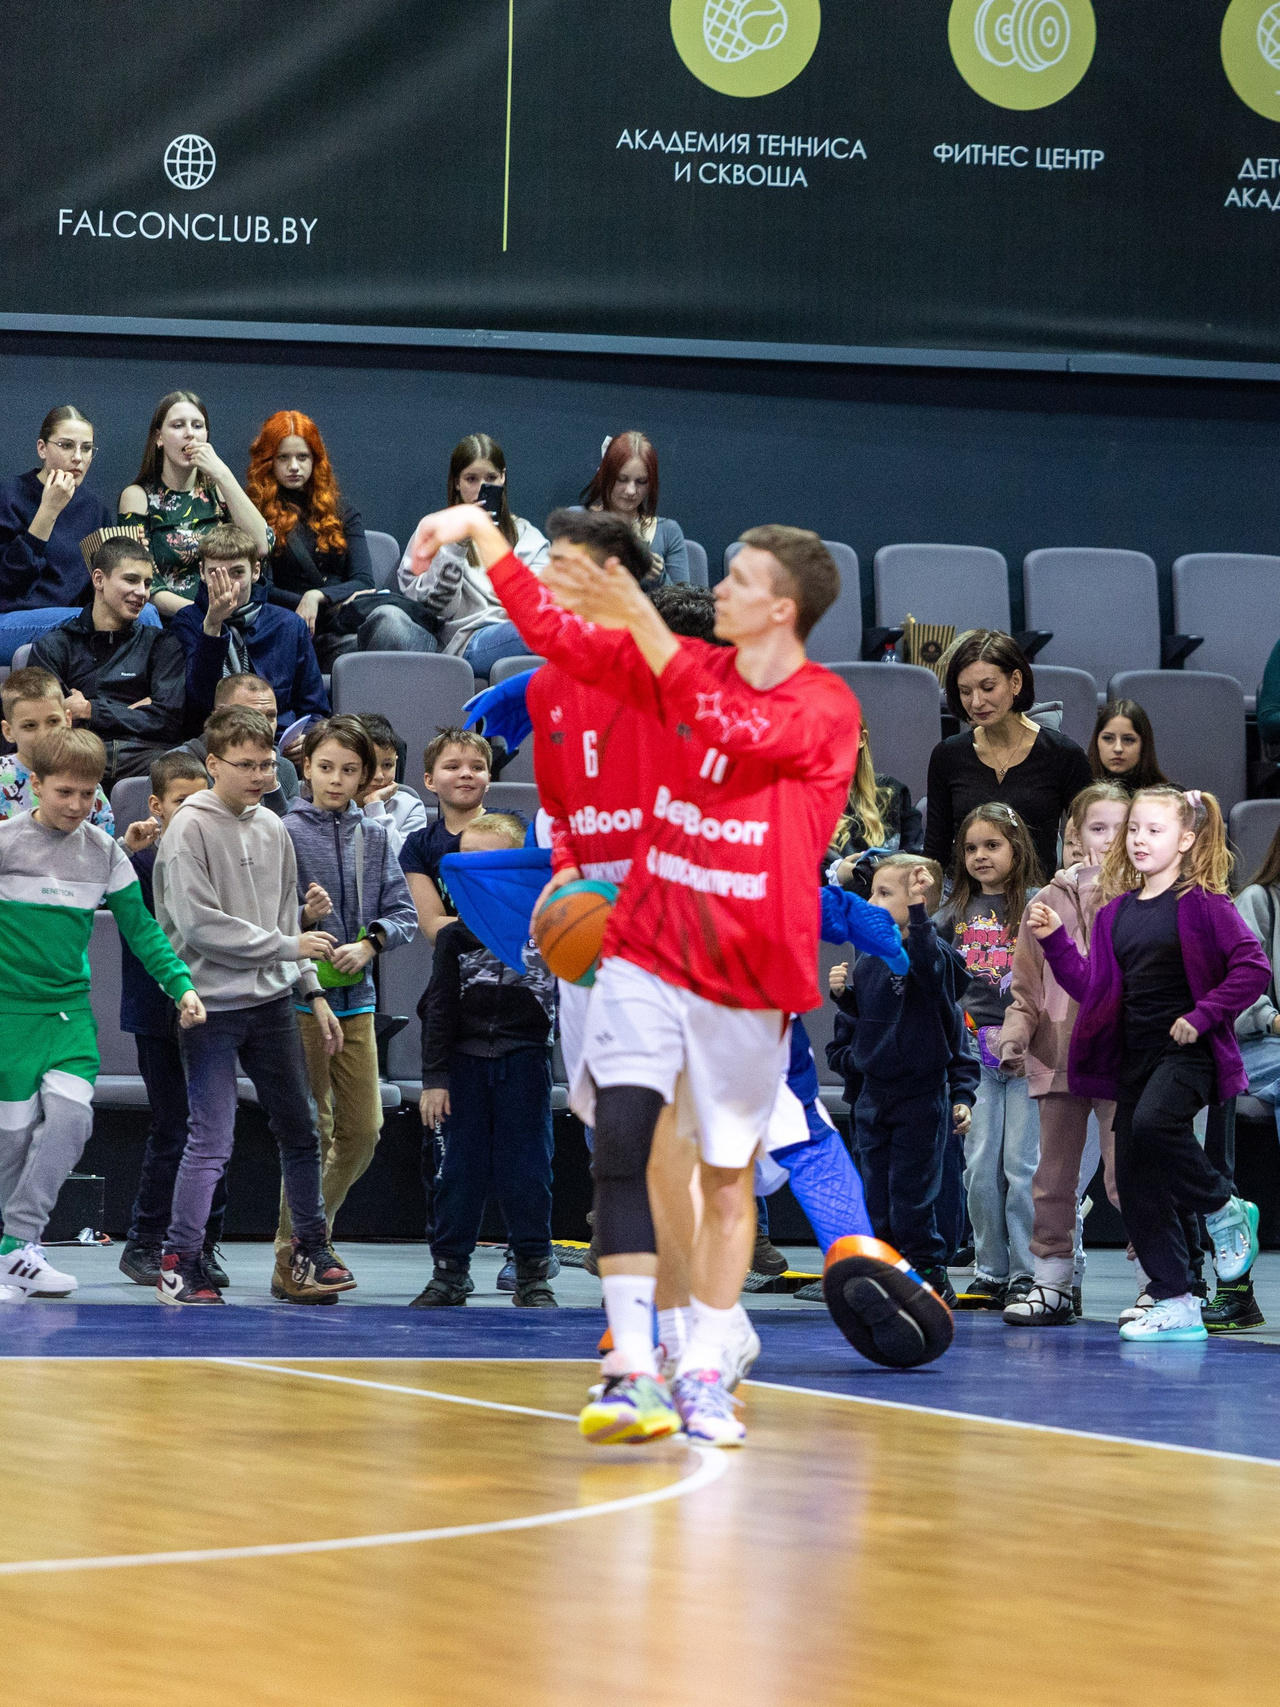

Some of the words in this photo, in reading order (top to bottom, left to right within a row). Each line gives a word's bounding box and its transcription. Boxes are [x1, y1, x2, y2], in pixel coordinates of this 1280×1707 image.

[615, 128, 750, 154] АКАДЕМИЯ
[756, 133, 867, 160] ТЕННИСА
[933, 142, 1029, 167] ФИТНЕС
[1035, 146, 1105, 170] ЦЕНТР
[674, 161, 691, 182] И
[698, 162, 808, 187] СКВОША
[58, 208, 318, 244] FALCONCLUB.BY
[582, 729, 599, 778] 6
[699, 747, 729, 784] 11
